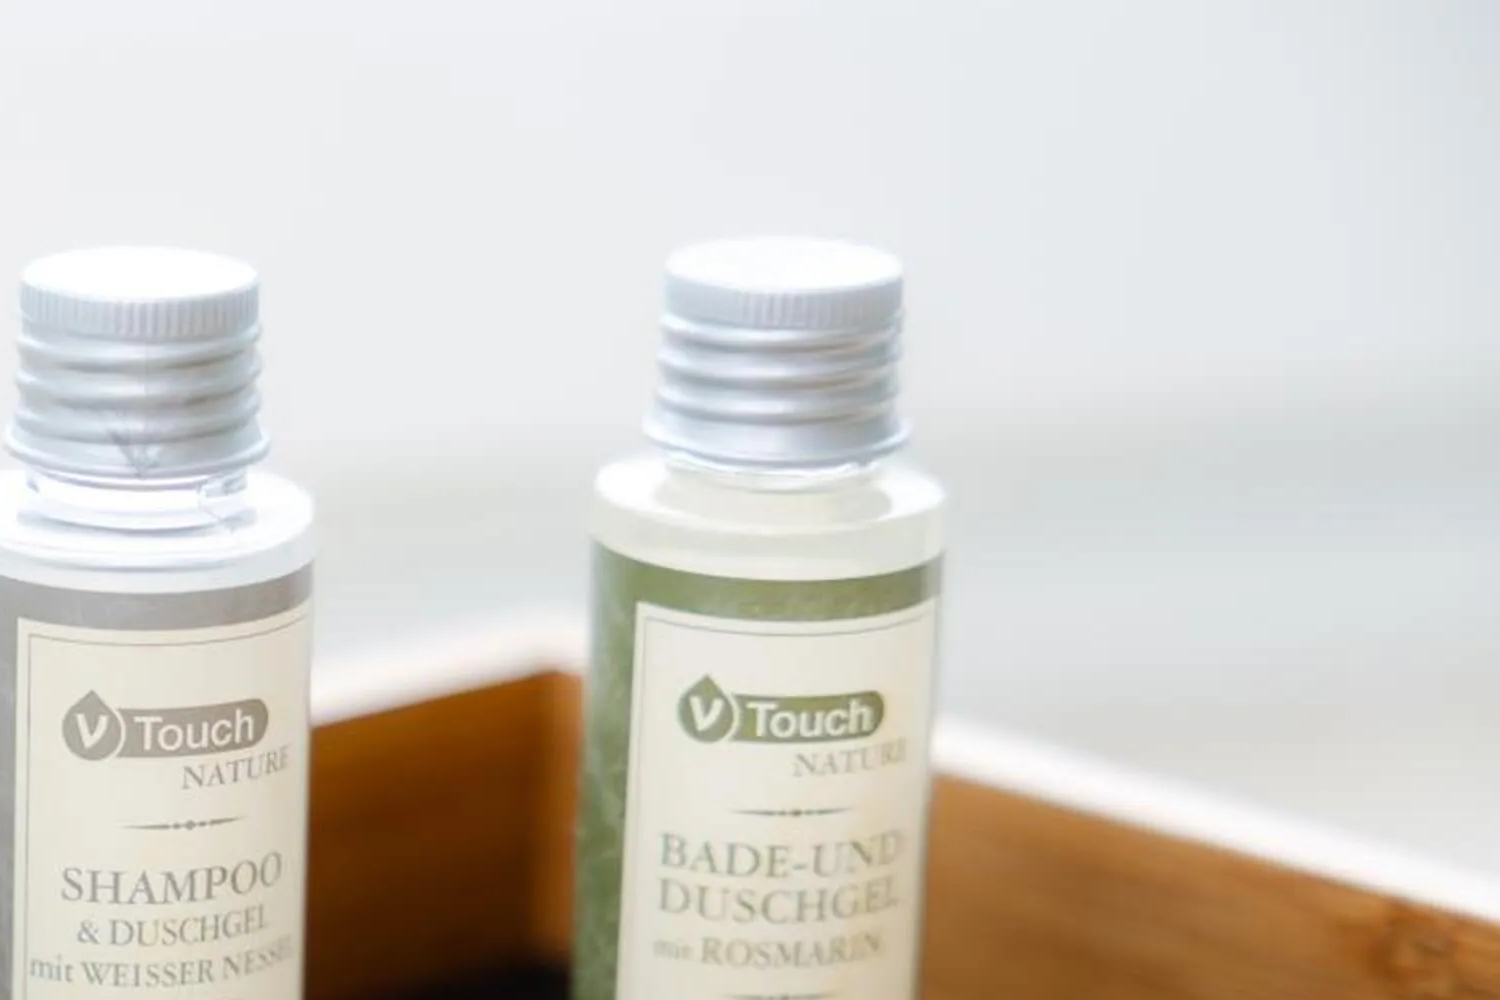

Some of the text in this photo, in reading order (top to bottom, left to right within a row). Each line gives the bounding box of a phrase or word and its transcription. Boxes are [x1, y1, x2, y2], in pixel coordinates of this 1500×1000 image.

[75, 708, 255, 751] V Touch
[688, 695, 875, 739] V Touch
[180, 744, 291, 791] NATURE
[791, 737, 908, 778] NATURE
[658, 828, 905, 879] BADE-UND
[60, 851, 283, 906] SHAMPOO
[657, 875, 900, 925] DUSCHGEL
[76, 903, 269, 948] & DUSCHGEL
[28, 953, 75, 984] mit
[79, 957, 216, 989] WEISSER
[699, 929, 884, 970] ROSMARIN
